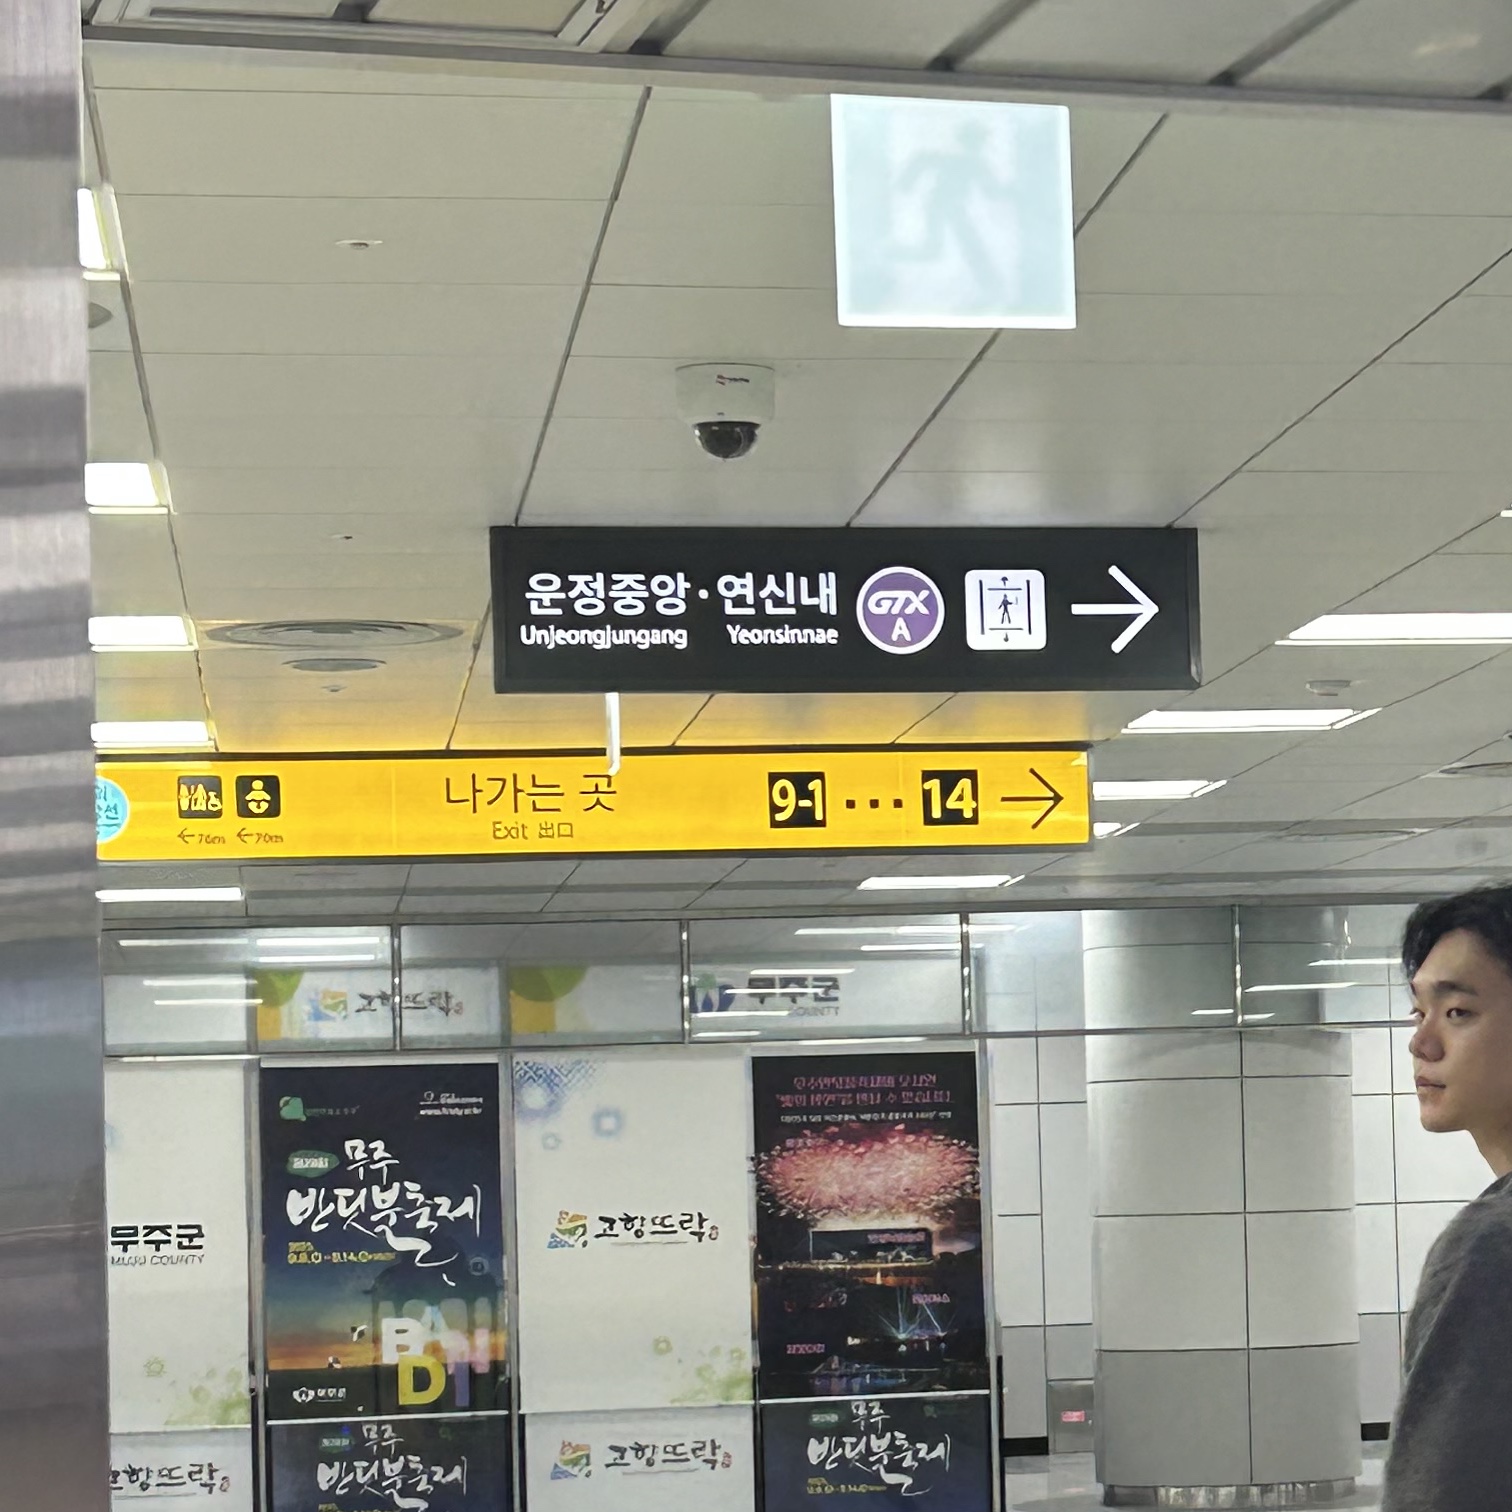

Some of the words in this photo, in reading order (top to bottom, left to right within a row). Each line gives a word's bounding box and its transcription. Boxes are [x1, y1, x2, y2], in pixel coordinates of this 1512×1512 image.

[868, 590, 931, 616] GTX
[520, 624, 688, 650] Unjeongjungang
[726, 624, 839, 646] Yeonsinnae
[890, 617, 911, 642] A
[445, 773, 565, 814] 나가는
[579, 774, 618, 813] 곳
[771, 778, 824, 822] 9-1
[923, 777, 978, 819] 14
[492, 821, 529, 840] Exit
[538, 821, 574, 839] 出口
[748, 977, 840, 1005] 무주군
[344, 1138, 400, 1186] 무주
[111, 1224, 205, 1253] 무주군
[286, 1180, 482, 1267] 반딧불축제
[594, 1212, 710, 1243] 고향뜨락
[150, 1254, 205, 1266] COUNTY
[851, 1400, 891, 1433] 무주
[362, 1423, 404, 1456] 무주
[604, 1438, 722, 1471] 고향뜨락
